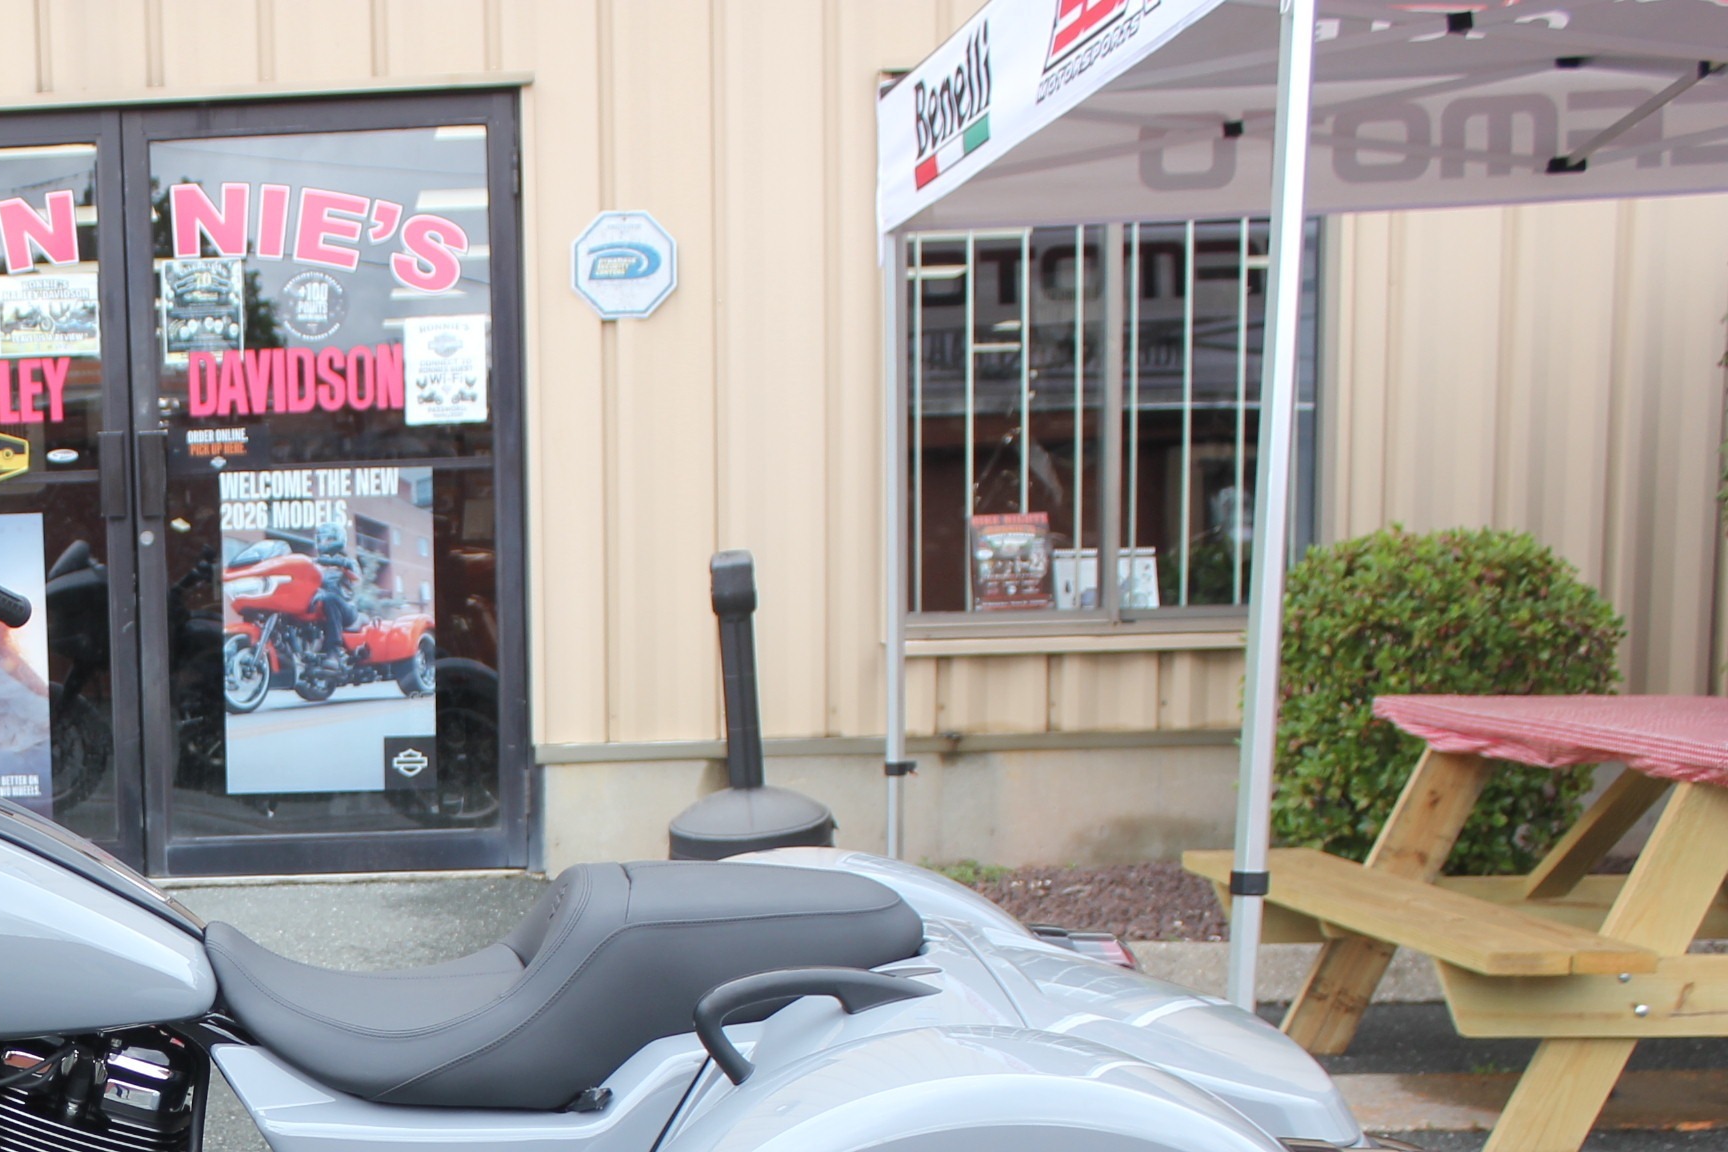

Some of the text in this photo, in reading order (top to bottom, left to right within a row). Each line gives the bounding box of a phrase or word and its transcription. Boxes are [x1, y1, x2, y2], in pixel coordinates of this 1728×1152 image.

[915, 18, 990, 159] Benelli
[188, 343, 405, 418] DAVIDSON
[186, 429, 214, 444] ORDER
[189, 443, 210, 456] PICK
[220, 467, 399, 501] WELCOME THE NEW
[220, 502, 269, 530] 2026
